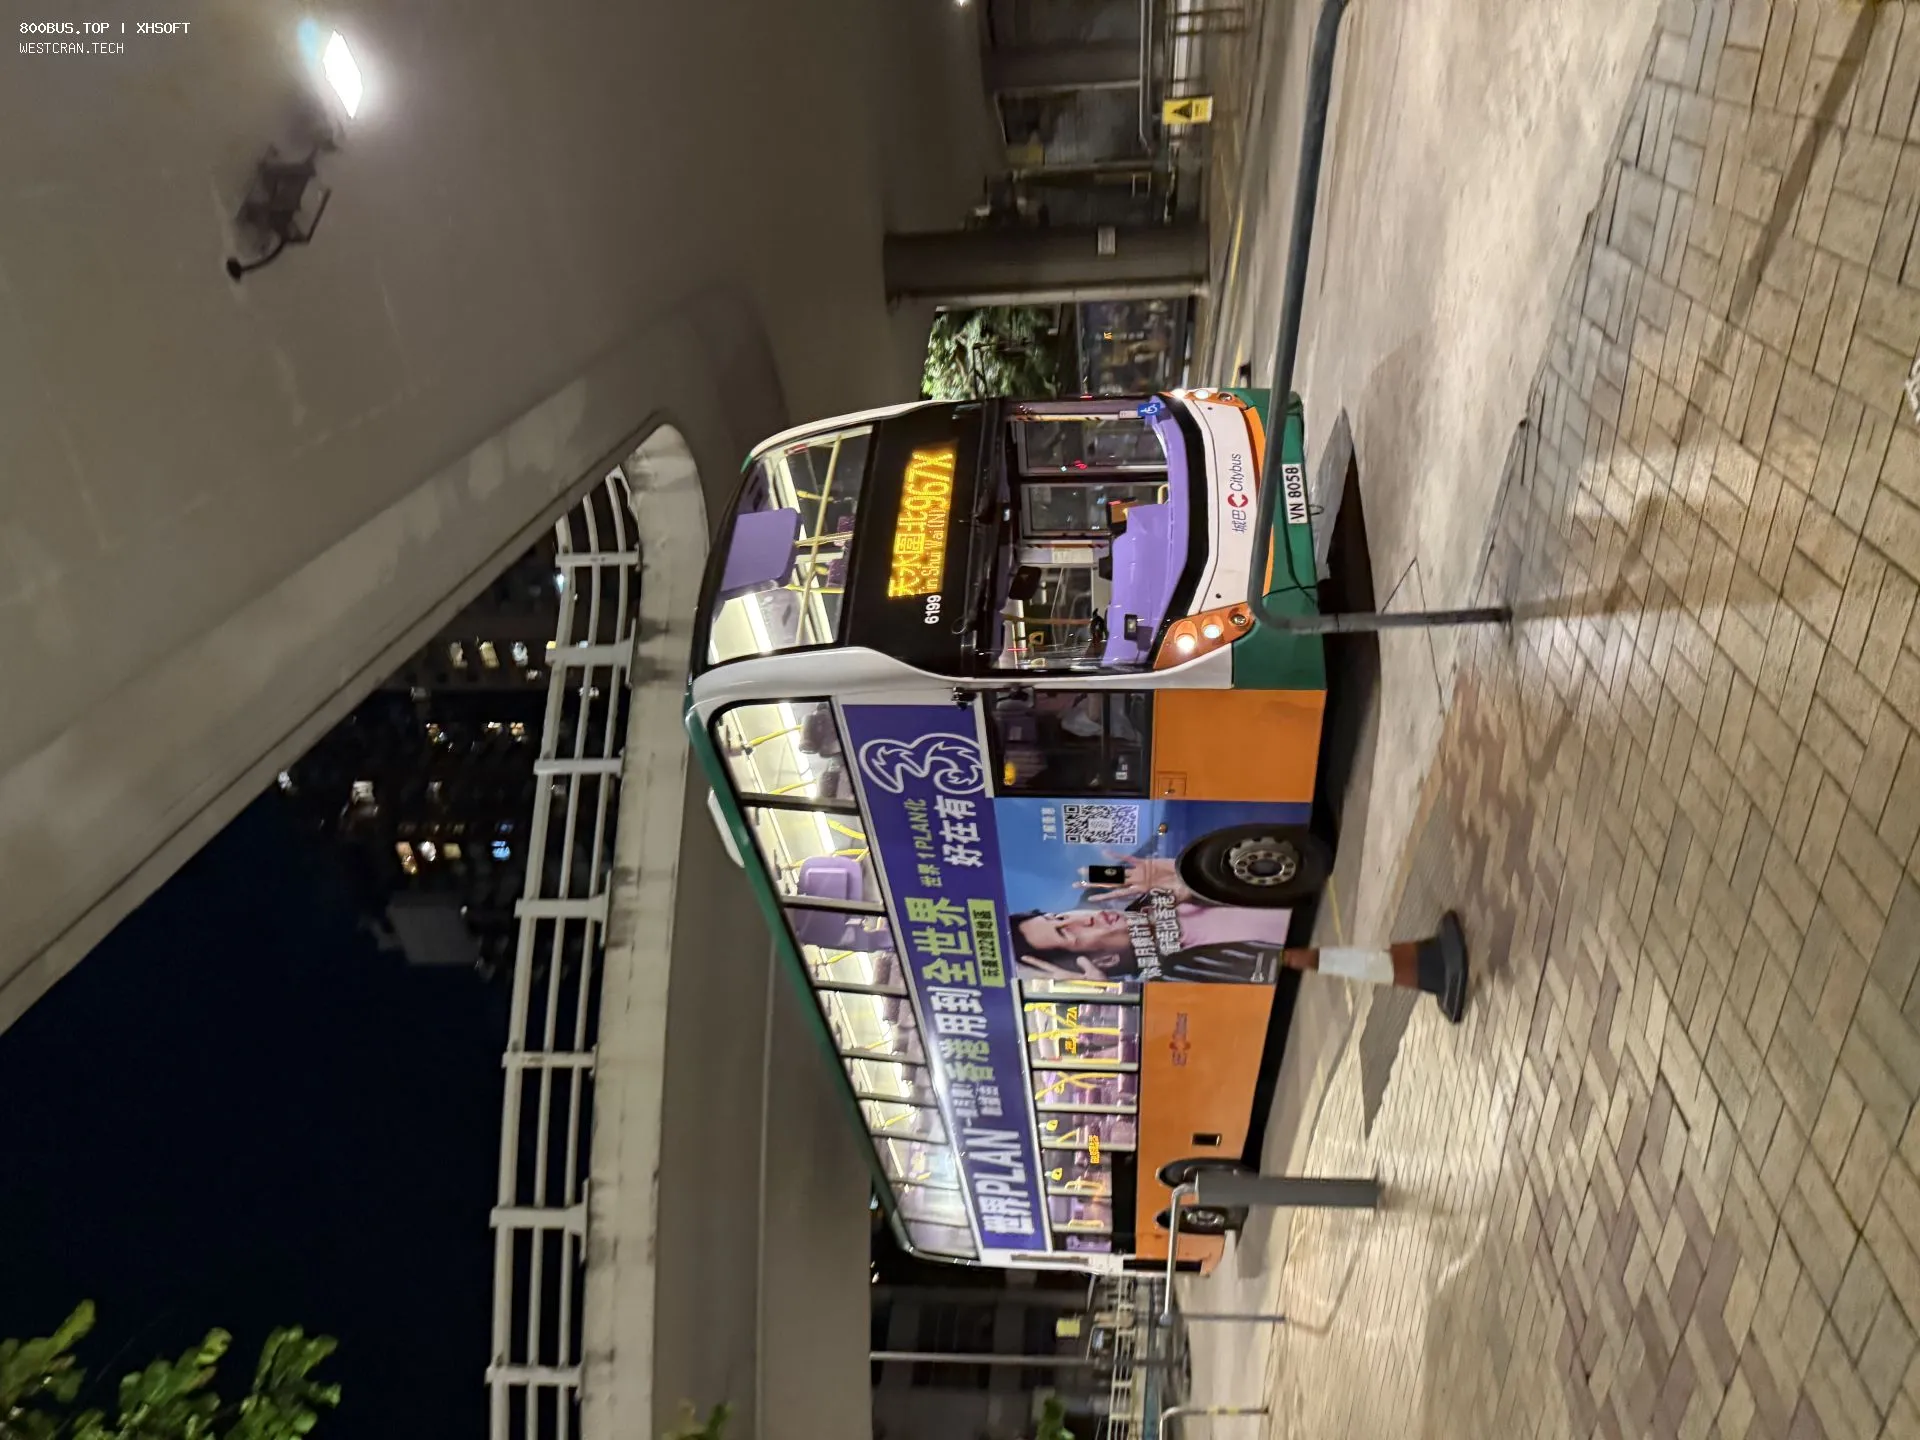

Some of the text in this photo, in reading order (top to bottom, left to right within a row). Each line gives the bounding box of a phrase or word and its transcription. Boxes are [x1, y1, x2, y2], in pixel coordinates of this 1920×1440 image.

[927, 508, 946, 528] (N)
[1228, 453, 1247, 534] 城巴 Citybus
[1285, 467, 1305, 520] VN 8058
[888, 451, 953, 597] 天水圍北 967X
[925, 530, 943, 550] Wai
[921, 552, 942, 576] Shui
[924, 594, 942, 625] 6199
[933, 794, 985, 868] 好在有
[962, 1127, 1035, 1234] 世界PLAN
